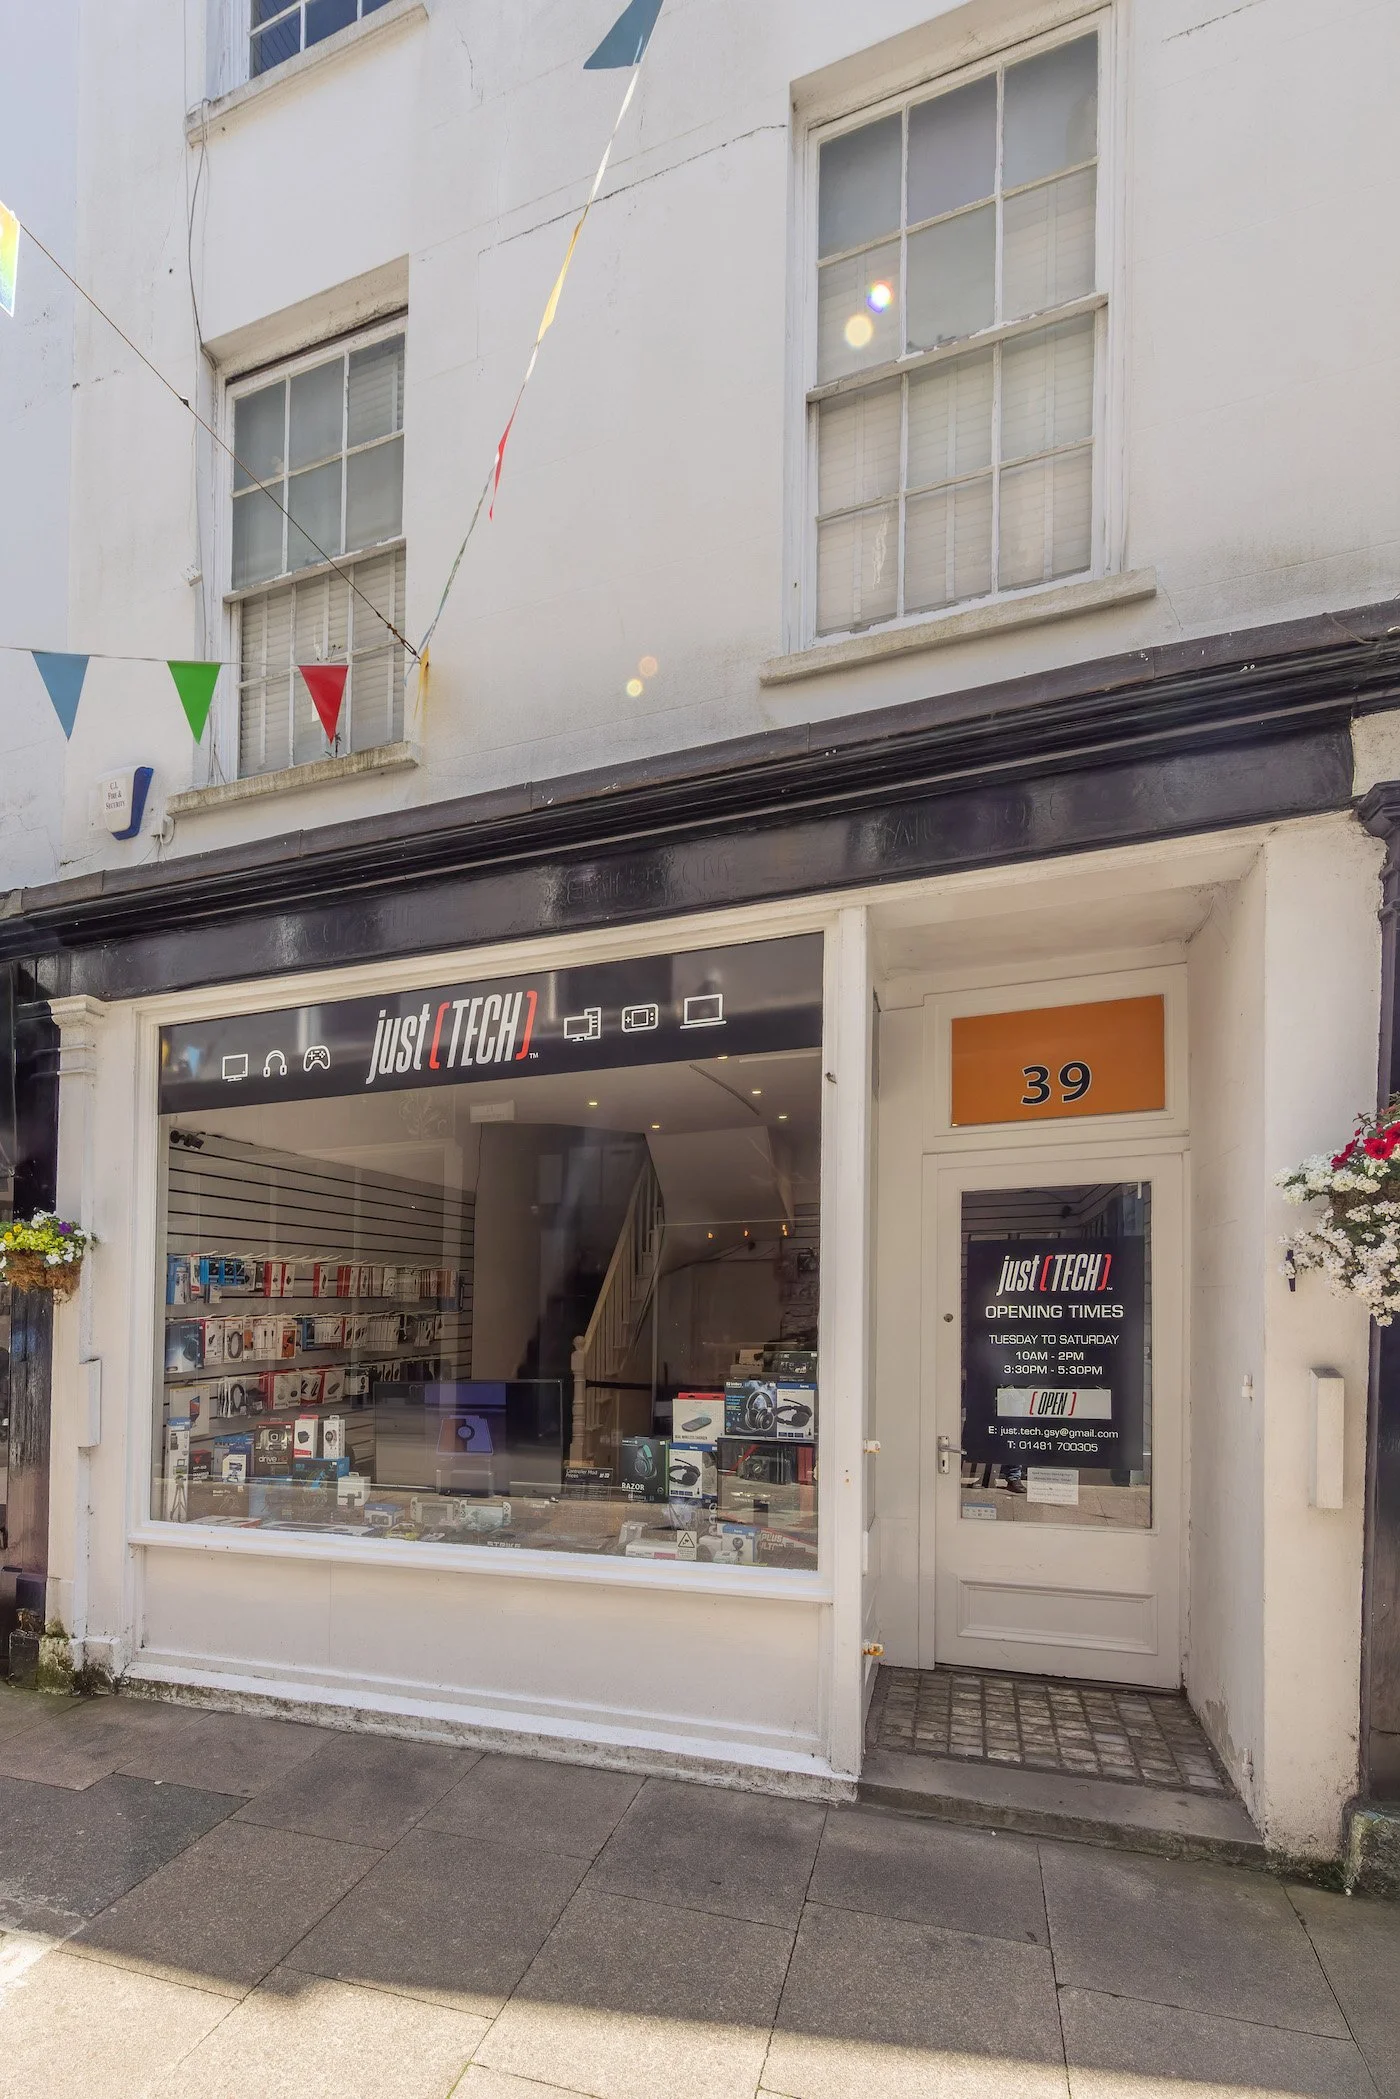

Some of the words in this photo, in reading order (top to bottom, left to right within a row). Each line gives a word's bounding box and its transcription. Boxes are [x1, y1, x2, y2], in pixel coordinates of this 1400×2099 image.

[1020, 1060, 1092, 1106] 39
[985, 1305, 1063, 1319] OPENING
[1068, 1304, 1124, 1319] TIMES
[989, 1334, 1038, 1345] TUESDAY
[1041, 1334, 1056, 1345] TO
[1059, 1334, 1120, 1345] SATURDAY
[1015, 1351, 1048, 1361] 10AM
[1058, 1351, 1084, 1361] 2PM
[1004, 1365, 1048, 1375] 3:30PM
[1058, 1365, 1103, 1375] 5:30PM
[988, 1425, 998, 1435] E:
[1000, 1426, 1119, 1439] just.tech.gsy@gmail.com
[1007, 1440, 1016, 1449] T:
[1019, 1441, 1052, 1450] 01481
[1056, 1442, 1099, 1452] 700305
[621, 1482, 645, 1491] RAZOR
